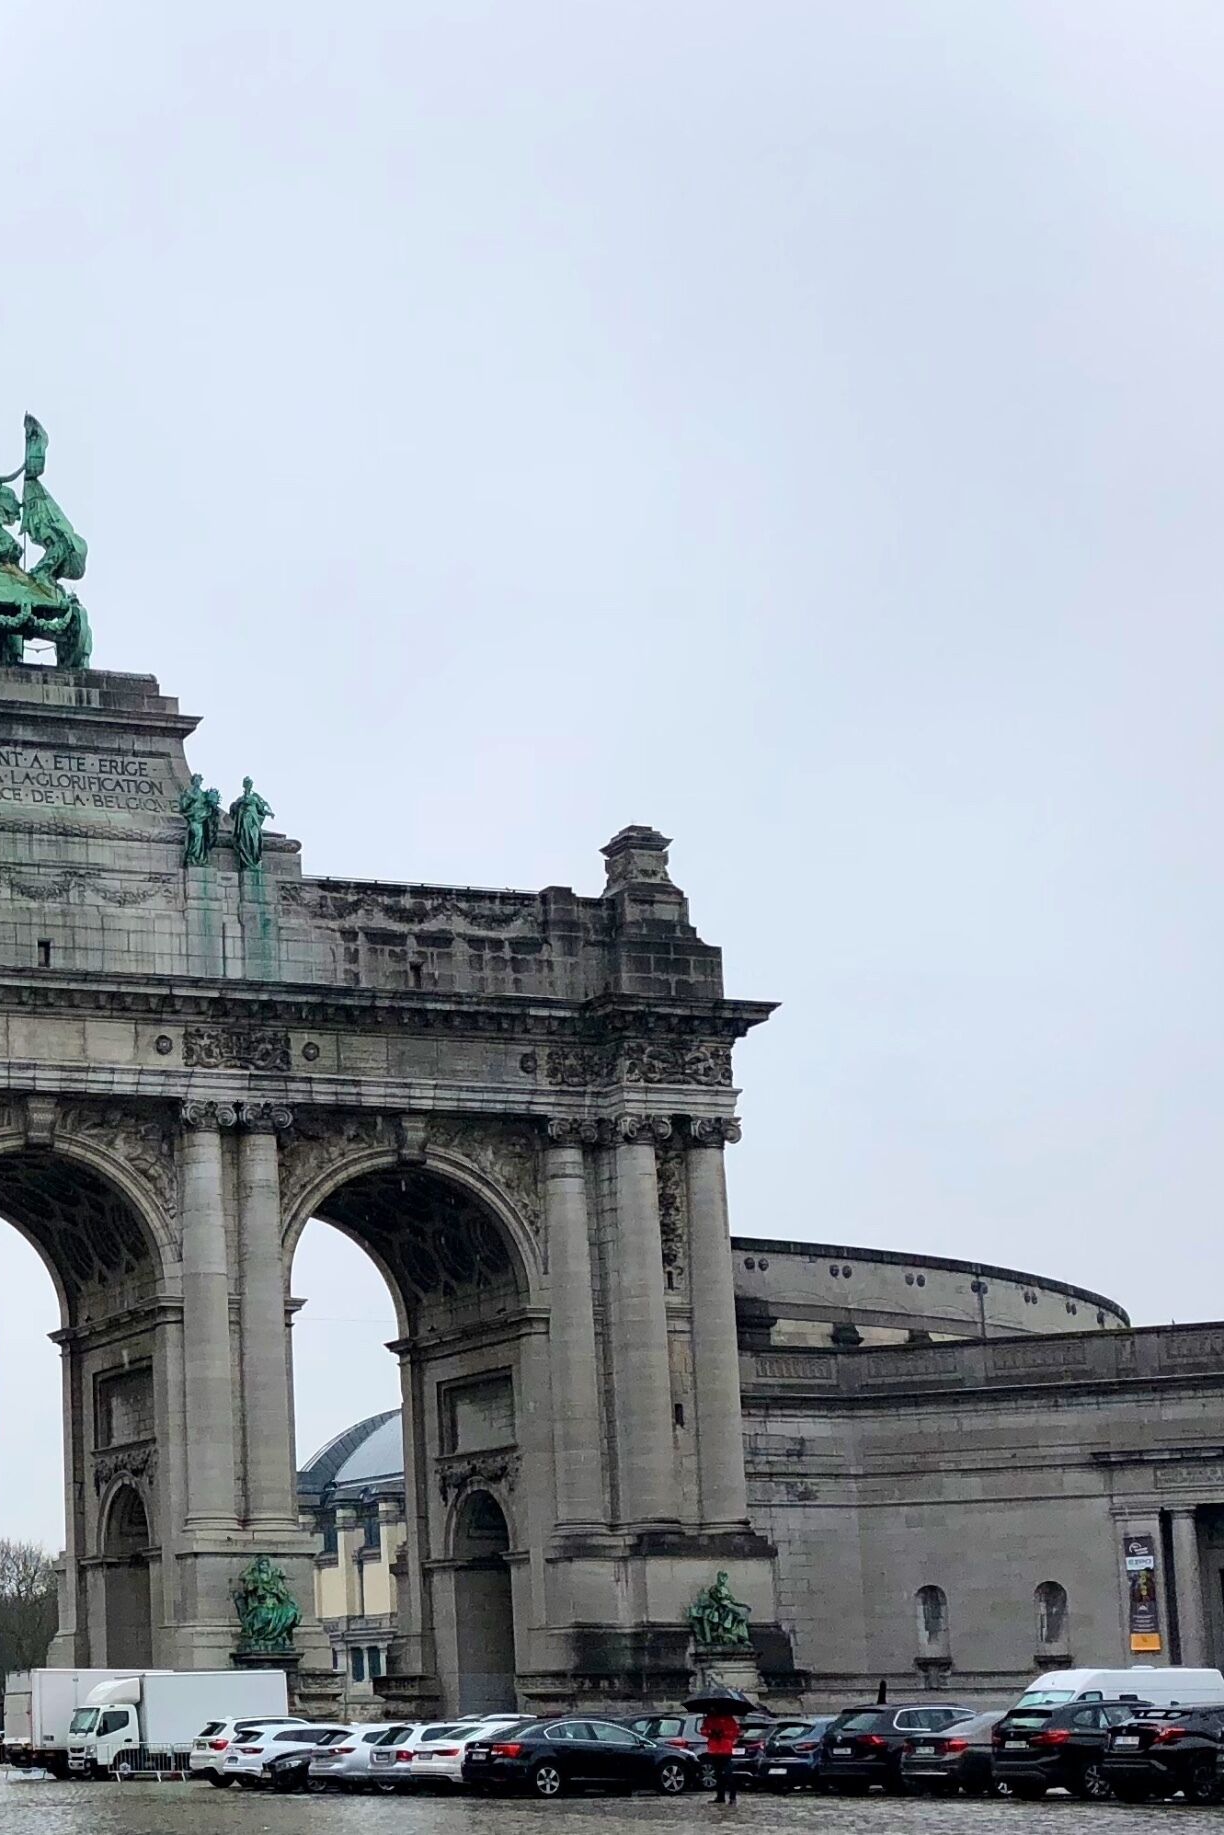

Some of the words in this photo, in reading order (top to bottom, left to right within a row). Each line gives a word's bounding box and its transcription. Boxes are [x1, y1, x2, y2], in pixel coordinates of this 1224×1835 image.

[30, 753, 44, 769] A
[53, 754, 87, 771] ETE
[32, 789, 55, 804] DE
[62, 791, 86, 806] LA
